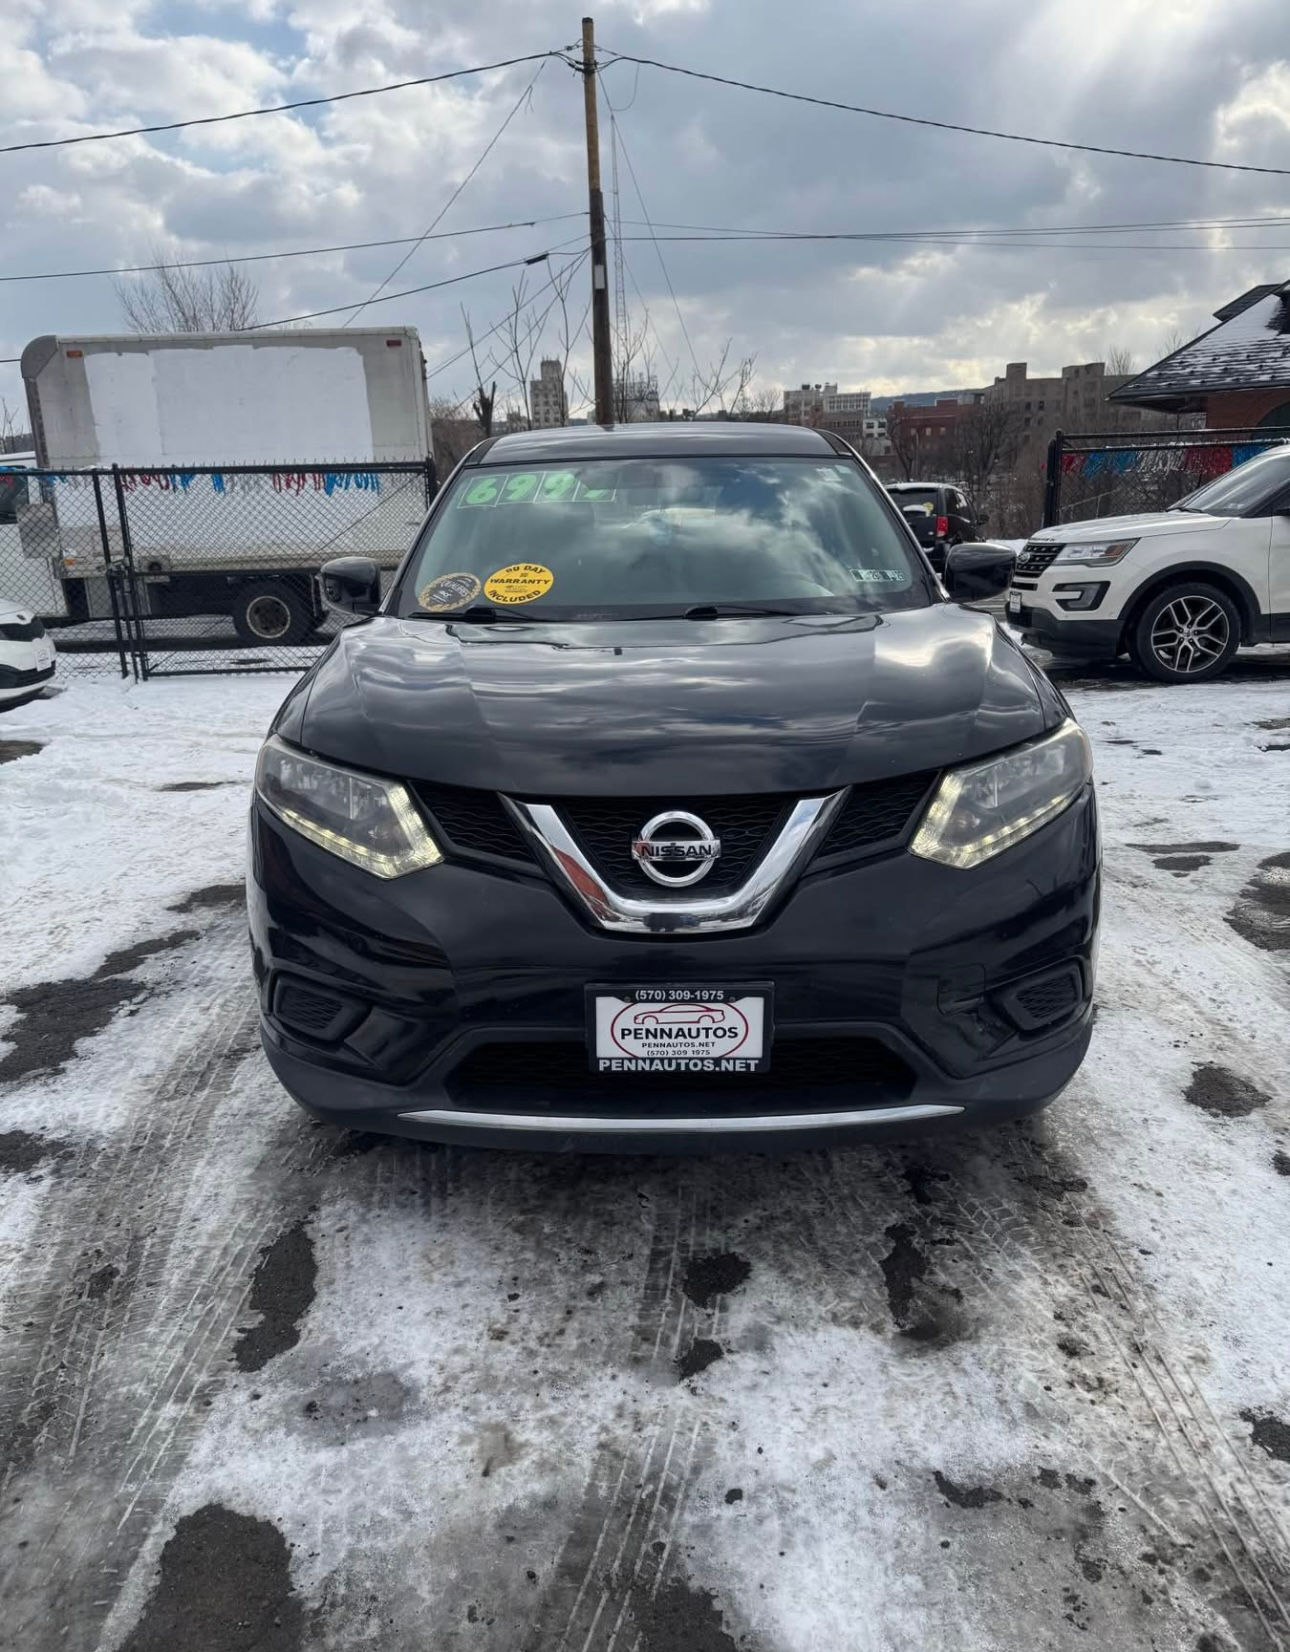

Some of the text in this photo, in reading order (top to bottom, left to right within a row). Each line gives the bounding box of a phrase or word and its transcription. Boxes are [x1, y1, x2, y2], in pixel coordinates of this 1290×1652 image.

[523, 565, 546, 574] DAY
[488, 589, 541, 602] INCLUDED
[641, 845, 712, 857] NISSAN
[635, 990, 724, 1001] (570) 309-1975
[620, 1026, 739, 1040] PENNAUTOS
[641, 1041, 716, 1049] PENNAUTOS.NET
[646, 1049, 669, 1057] (570)
[598, 1058, 760, 1072] PENNAUTOS.NET
